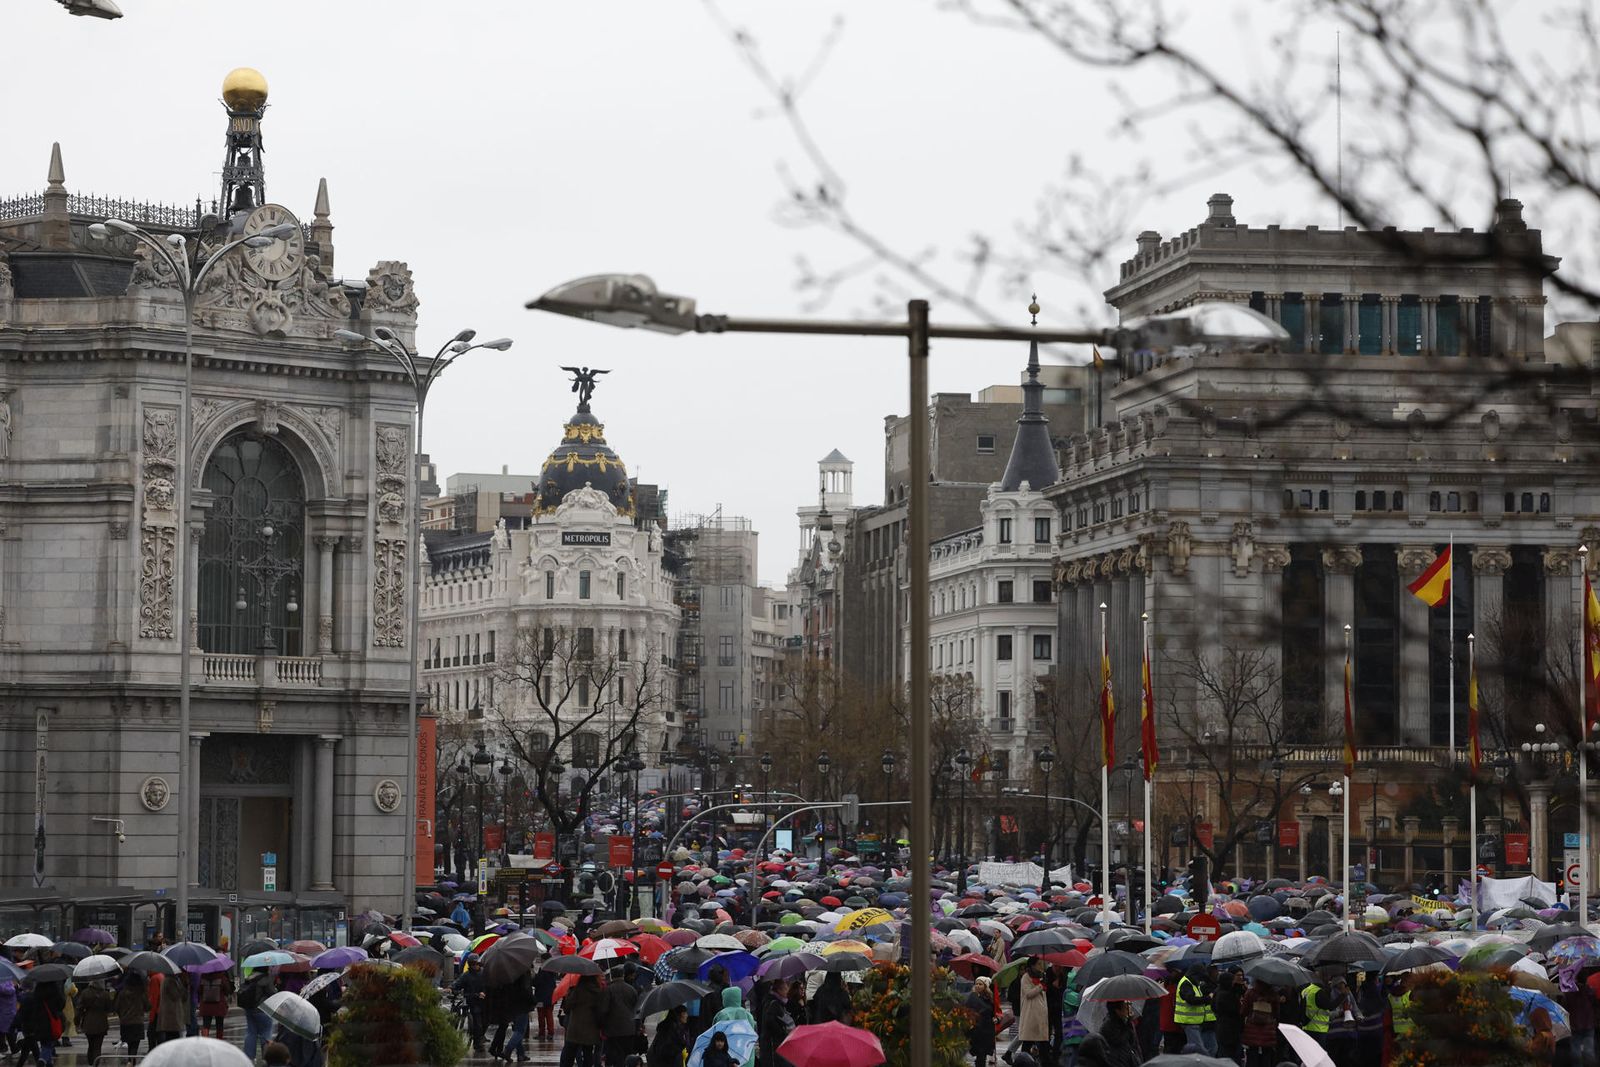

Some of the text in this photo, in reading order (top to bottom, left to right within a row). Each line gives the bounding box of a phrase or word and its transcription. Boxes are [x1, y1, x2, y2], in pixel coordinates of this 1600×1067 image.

[564, 534, 609, 543] METROPOLIS
[420, 731, 428, 771] CRONOS
[419, 773, 427, 786] DE
